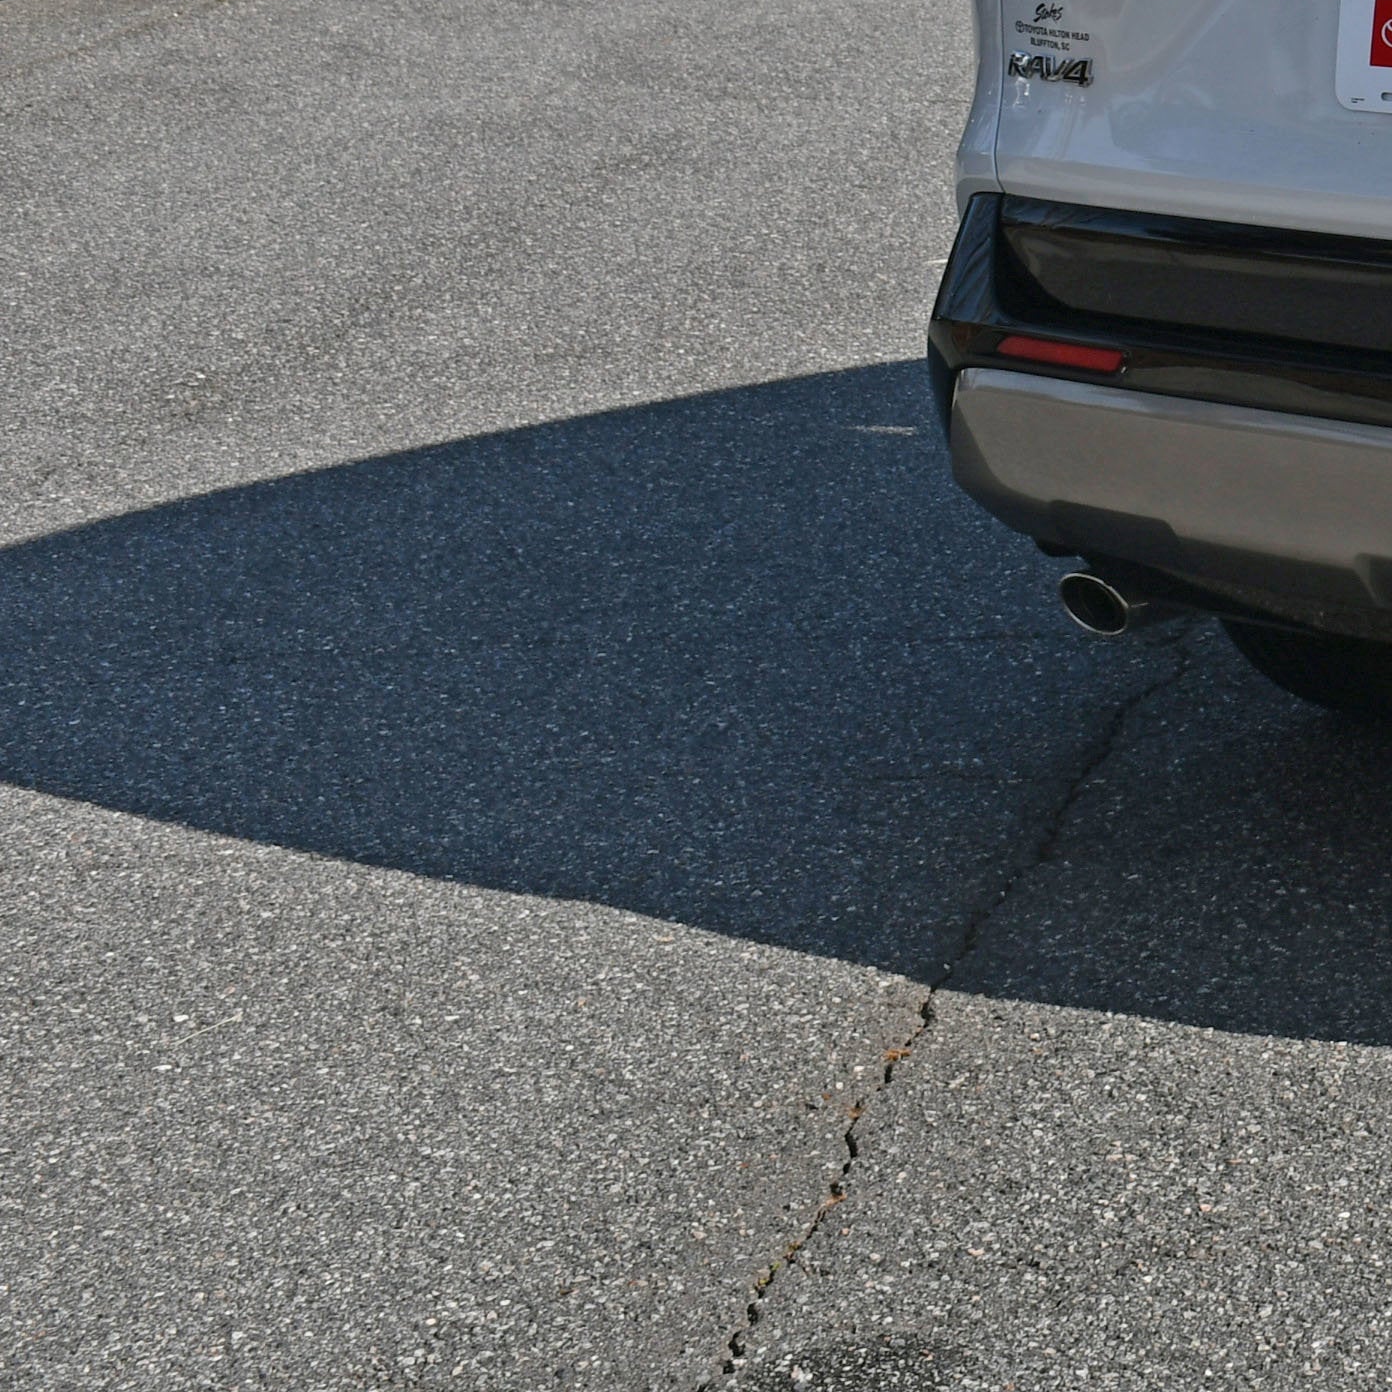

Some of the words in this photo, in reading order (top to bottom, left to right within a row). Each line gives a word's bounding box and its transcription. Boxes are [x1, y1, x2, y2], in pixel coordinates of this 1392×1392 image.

[1023, 24, 1047, 36] TOYOTA
[1047, 29, 1071, 39] HILTON
[1071, 31, 1090, 41] HEAD
[1008, 50, 1094, 88] RAV4
